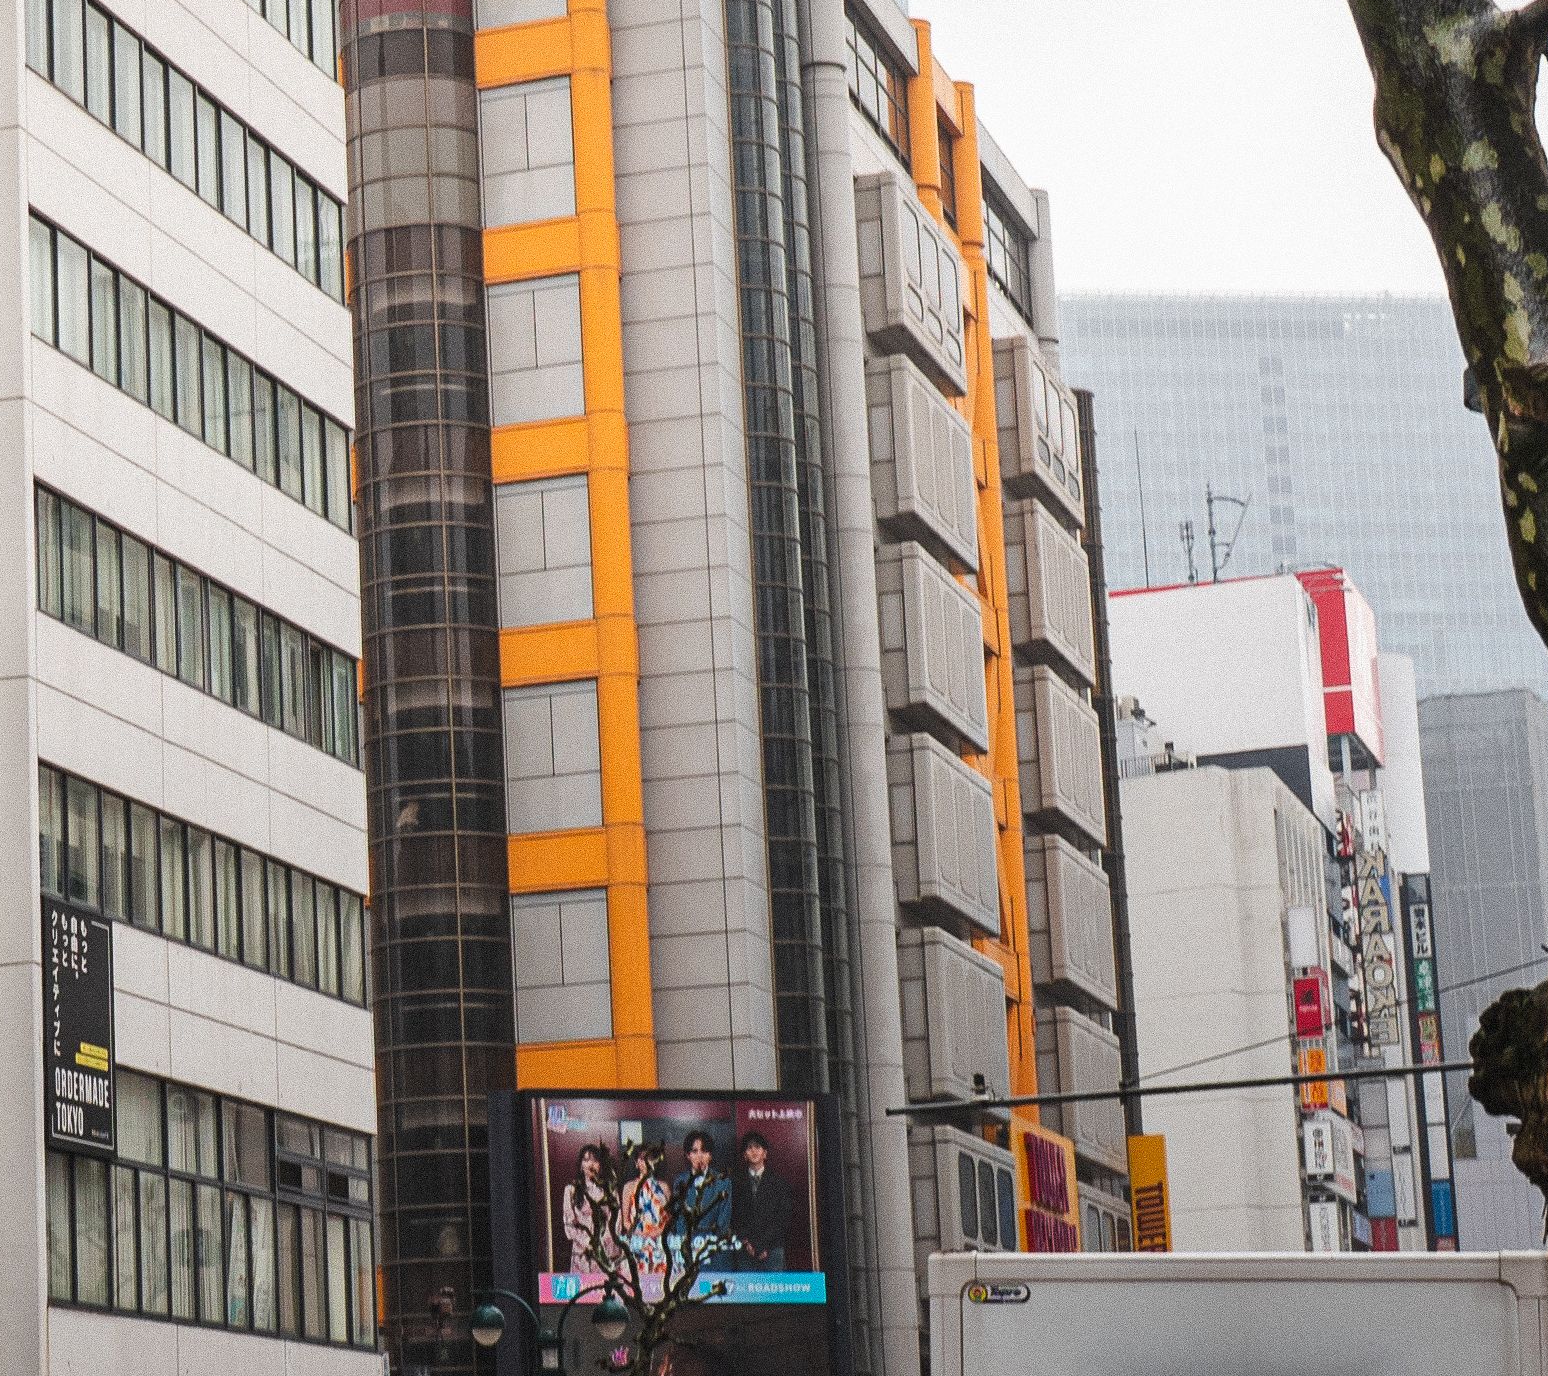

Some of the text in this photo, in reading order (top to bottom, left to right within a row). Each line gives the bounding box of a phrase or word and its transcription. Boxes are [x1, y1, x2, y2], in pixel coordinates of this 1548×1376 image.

[54, 1065, 111, 1109] ORDERMADE
[55, 1102, 85, 1137] TOKYO
[747, 1281, 812, 1294] ROADSHOW
